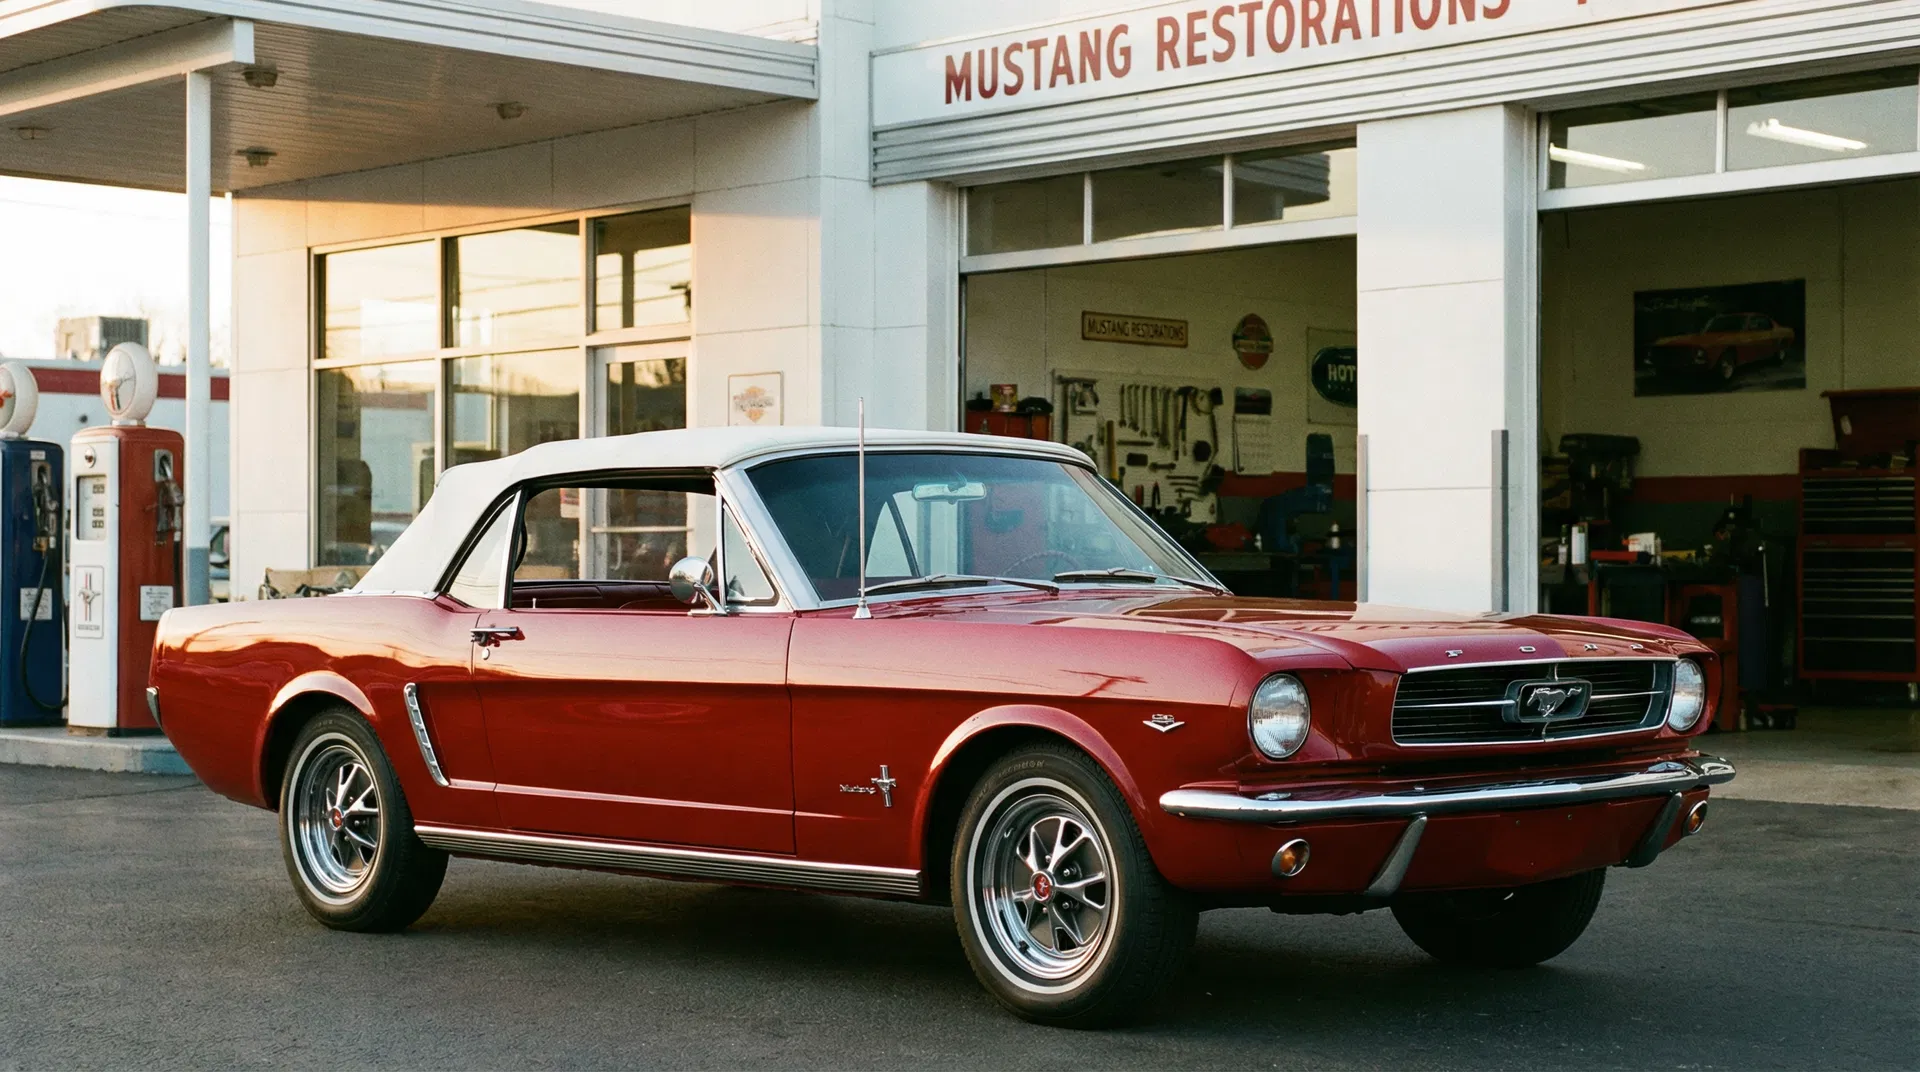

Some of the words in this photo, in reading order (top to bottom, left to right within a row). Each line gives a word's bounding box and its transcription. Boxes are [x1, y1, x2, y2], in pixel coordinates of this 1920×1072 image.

[945, 23, 1132, 105] MUSTANG
[1156, 0, 1511, 72] RESTORATIO
[1087, 317, 1130, 338] MUSTANG
[1327, 363, 1357, 383] HOT
